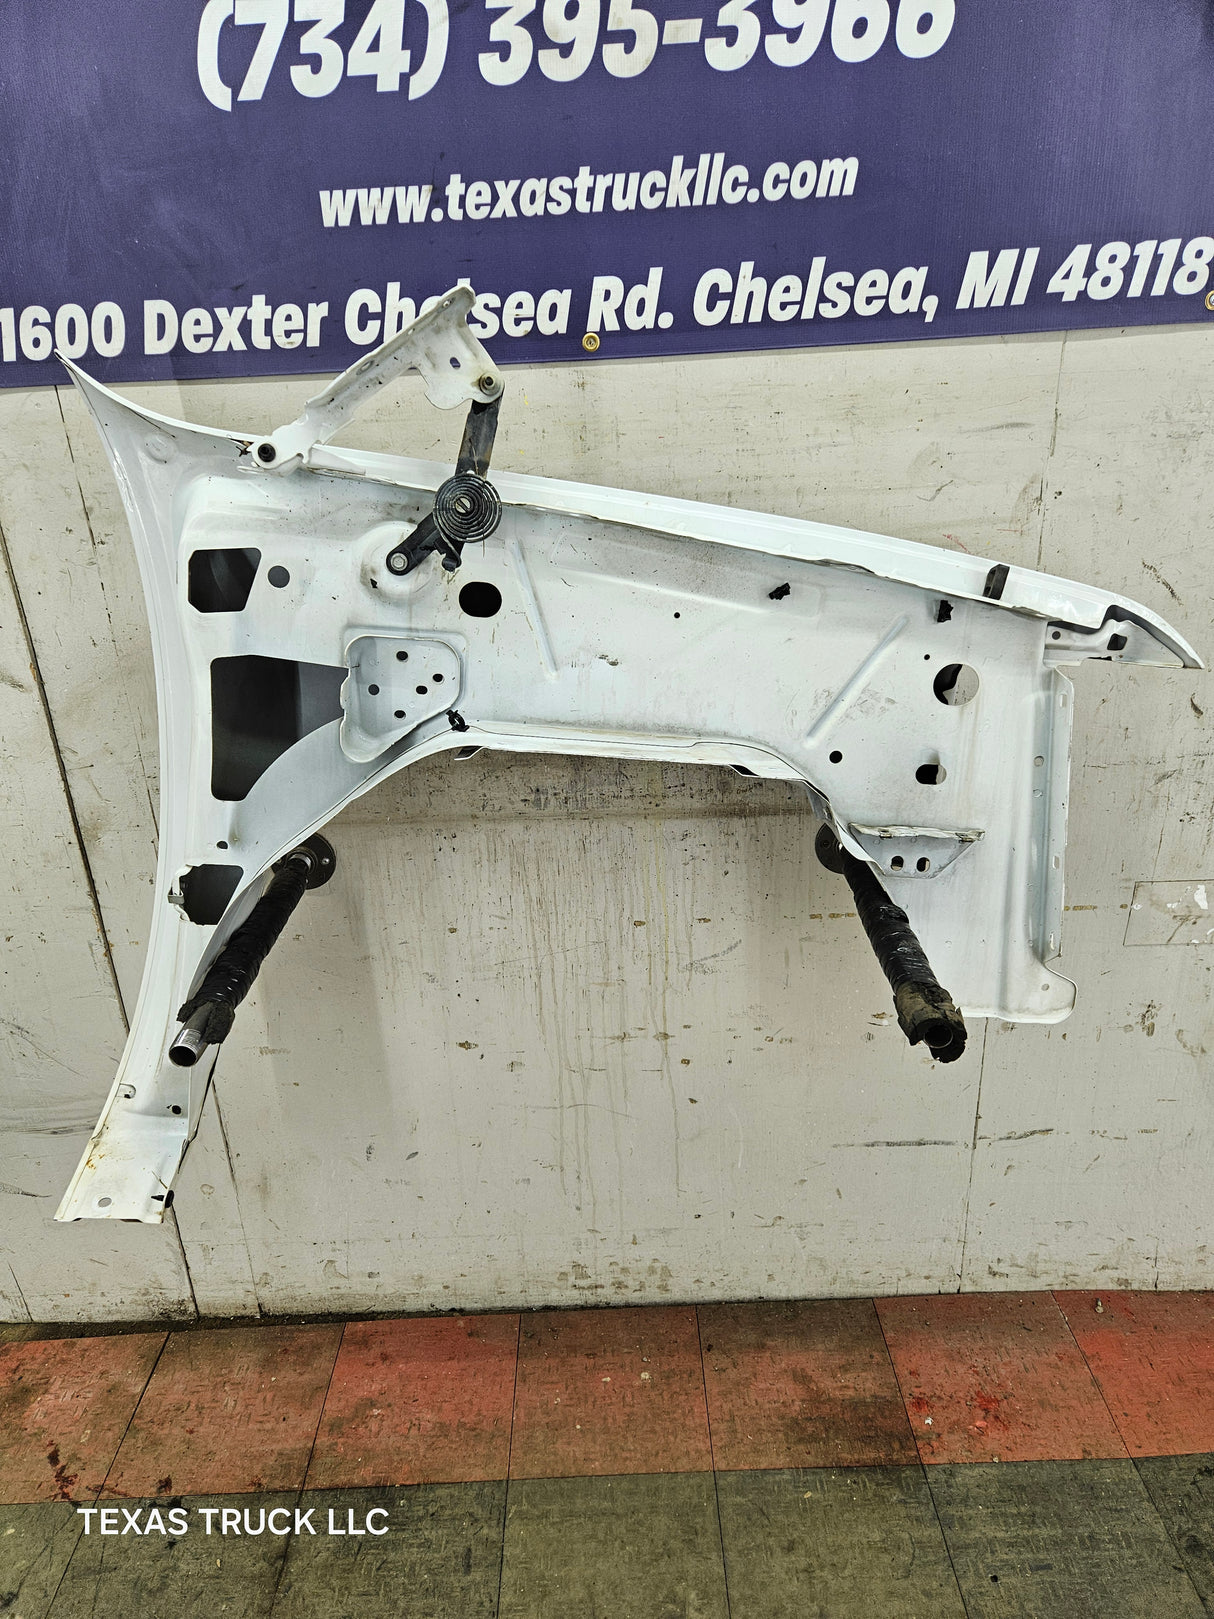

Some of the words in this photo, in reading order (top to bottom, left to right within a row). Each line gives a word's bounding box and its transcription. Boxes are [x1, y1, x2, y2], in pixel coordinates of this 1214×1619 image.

[197, 0, 450, 112] (734)
[319, 152, 860, 228] www.texastruckllc.com
[143, 294, 329, 356] Dexter
[345, 277, 573, 346] Chsea
[586, 267, 674, 332] Rd.
[693, 256, 940, 323] Chelsea,
[955, 247, 1041, 310] MI
[1046, 236, 1214, 302] 48118
